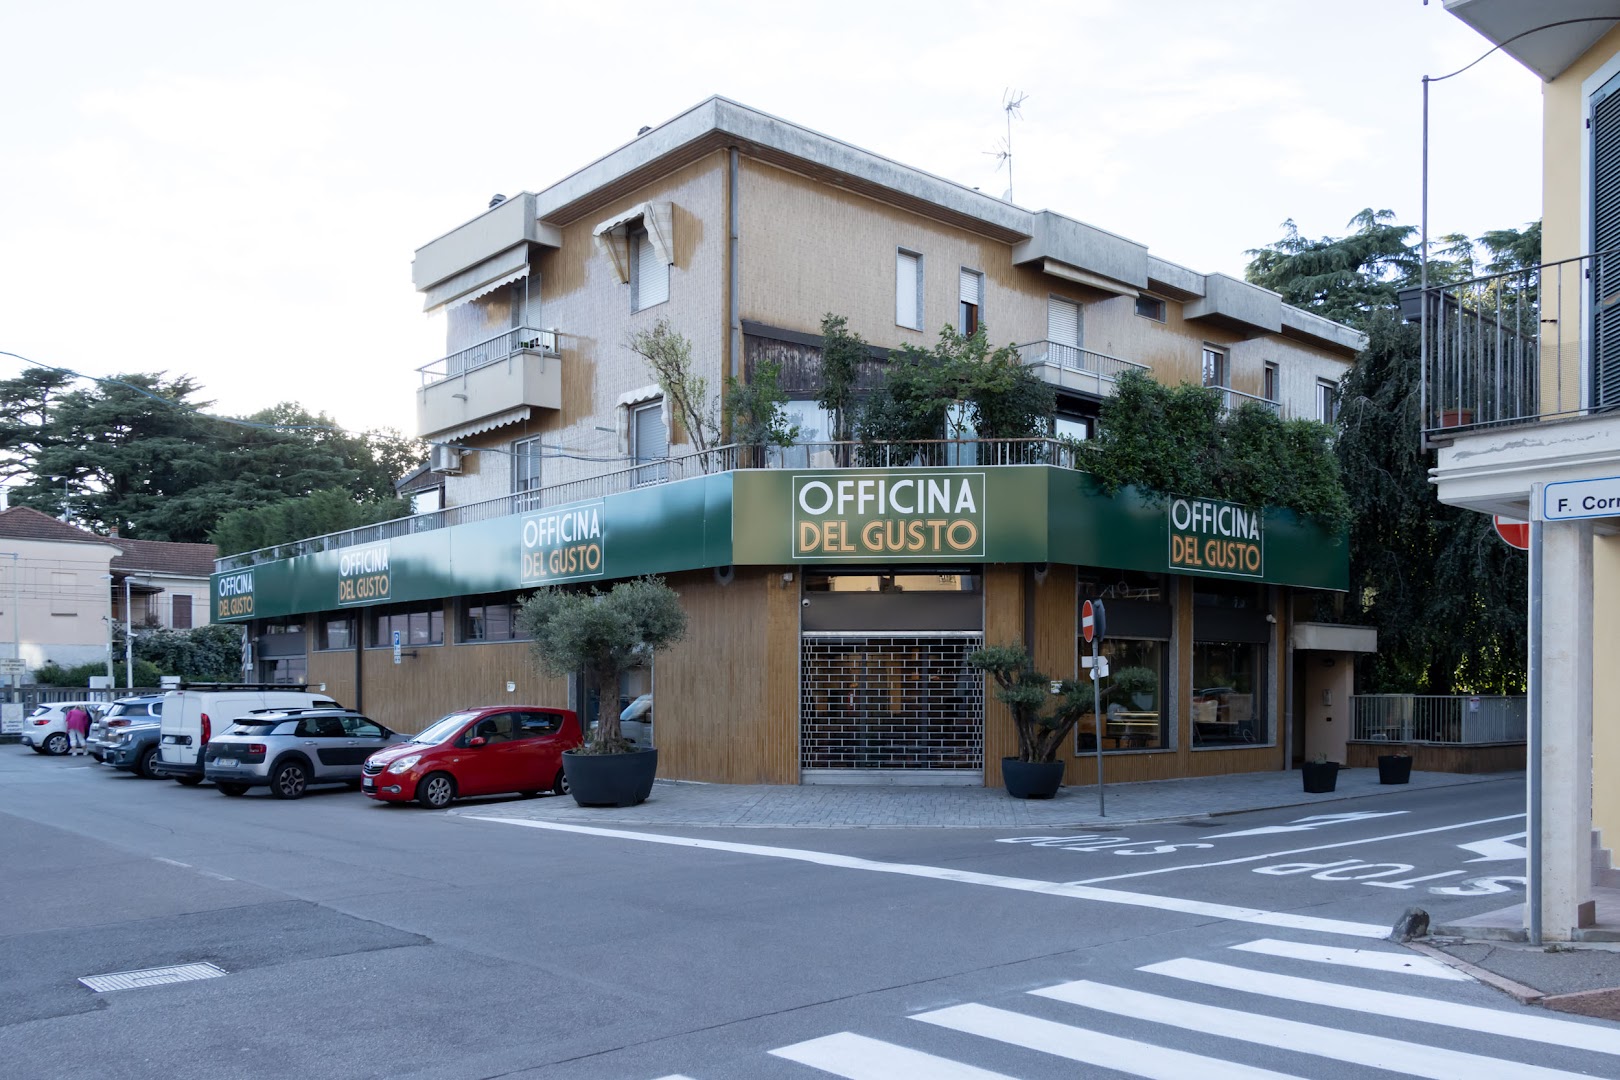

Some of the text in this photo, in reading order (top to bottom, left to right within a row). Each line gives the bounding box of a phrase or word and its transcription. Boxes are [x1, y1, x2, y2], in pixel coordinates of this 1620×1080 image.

[798, 478, 977, 516] OFFICINA
[1558, 498, 1572, 512] F.
[523, 508, 600, 548] OFFICINA
[799, 519, 979, 553] DEL GUSTO
[1172, 499, 1260, 541] OFFICINA
[340, 547, 389, 577] OFFICINA
[523, 543, 601, 578] DEL GUSTO
[1172, 534, 1261, 572] DEL GUSTO
[219, 572, 253, 597] OFFICINA
[340, 575, 389, 601] DEL GUSTO
[219, 595, 253, 617] DEL GUSTO
[994, 834, 1215, 856] STOP
[1251, 858, 1527, 896] STOP
